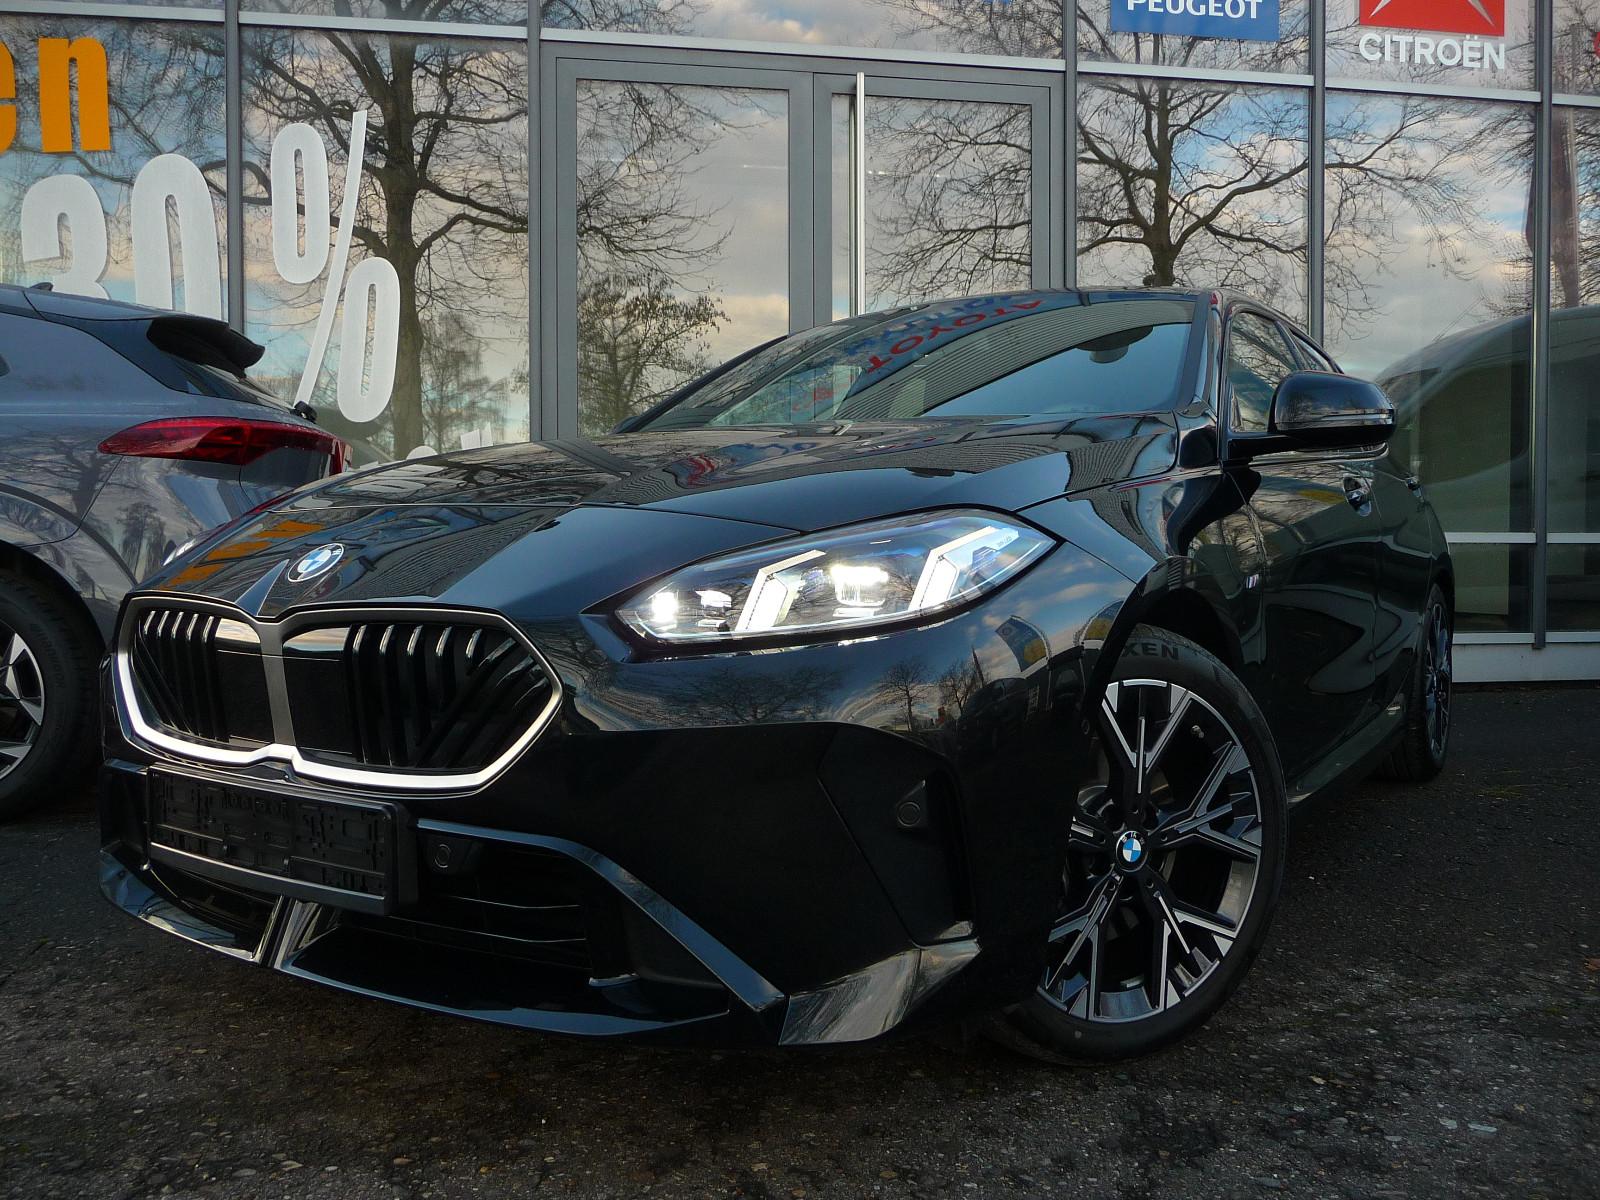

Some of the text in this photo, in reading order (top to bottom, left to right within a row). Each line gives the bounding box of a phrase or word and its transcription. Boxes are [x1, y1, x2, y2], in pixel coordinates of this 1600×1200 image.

[1127, 0, 1263, 19] PEUGEOT
[1358, 33, 1505, 70] CITROËN
[0, 36, 111, 153] n
